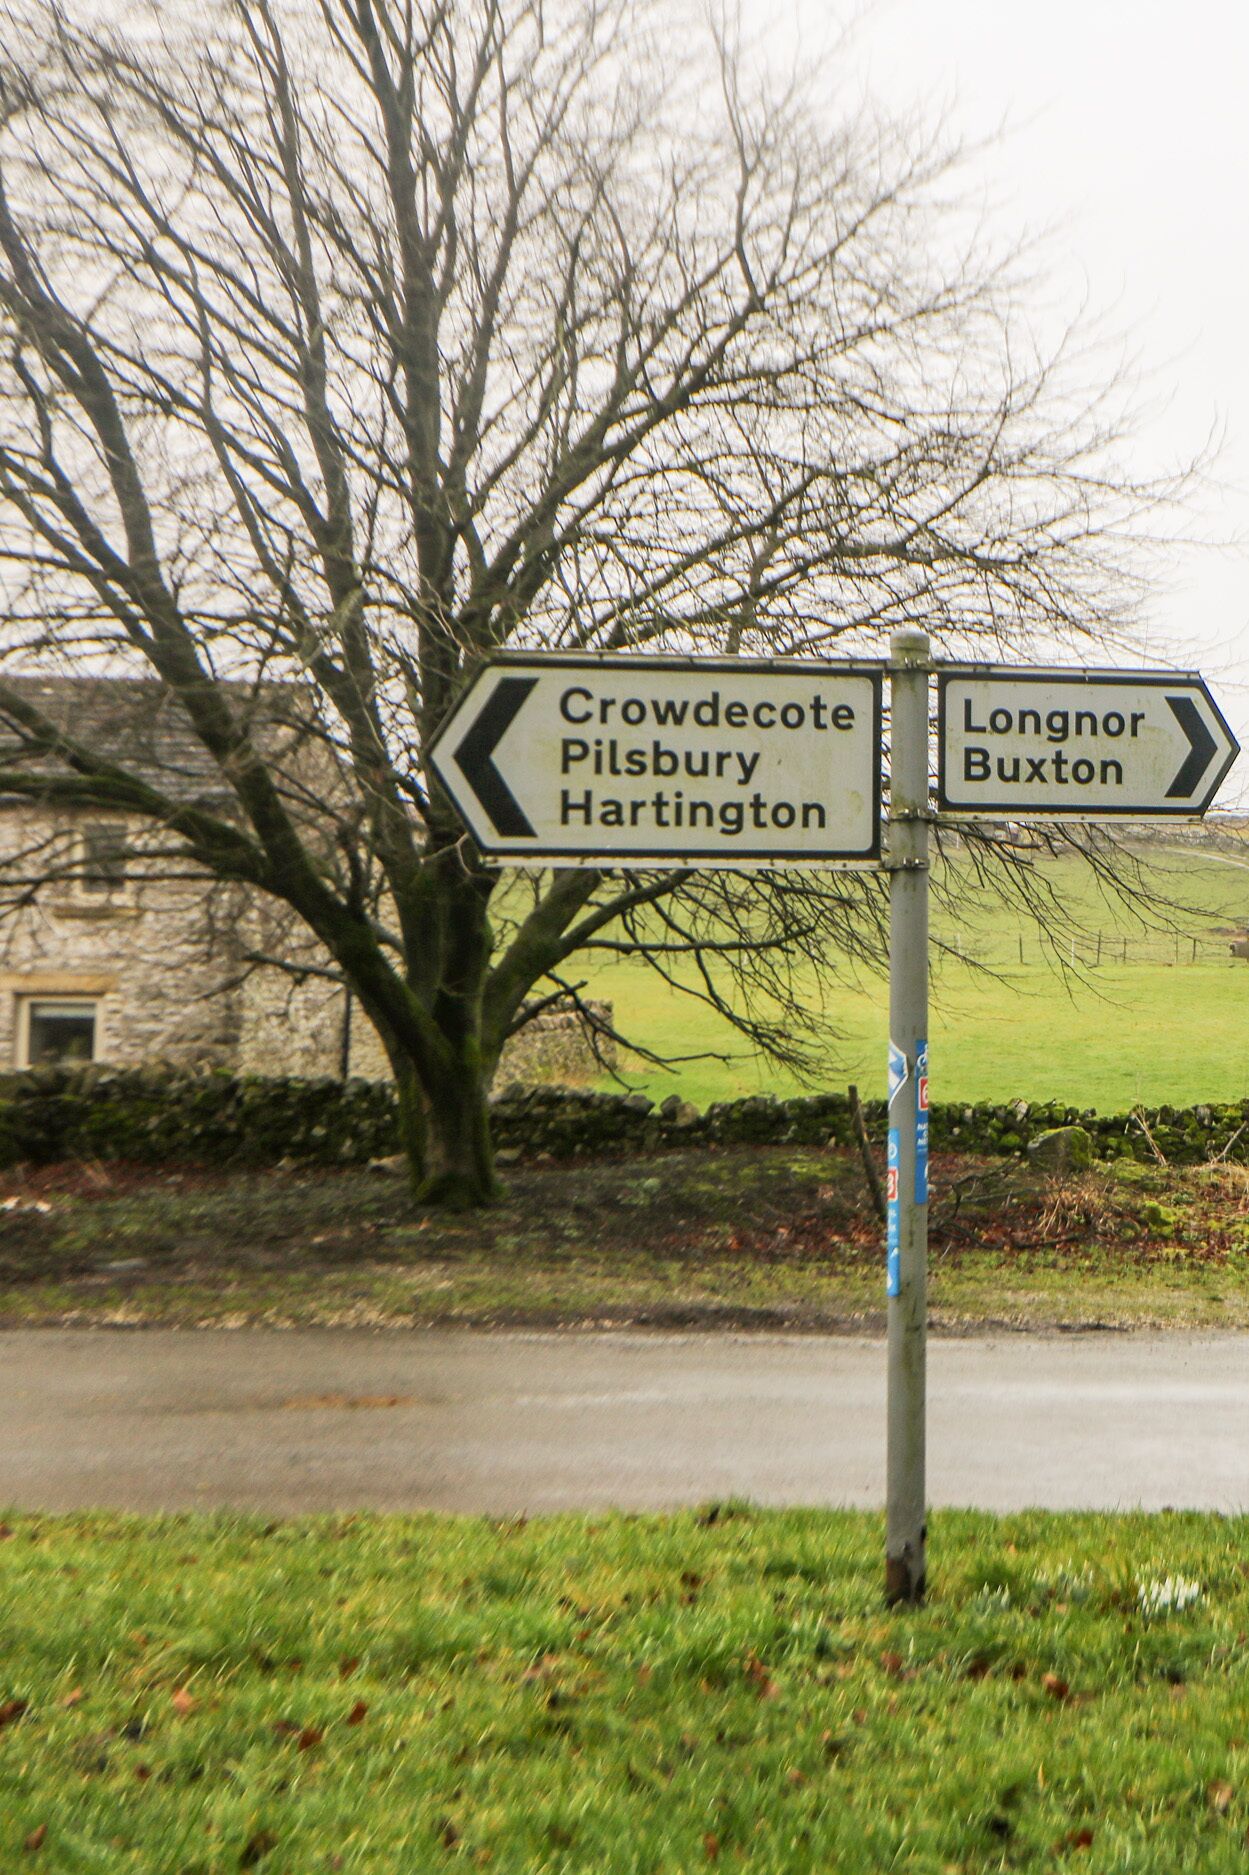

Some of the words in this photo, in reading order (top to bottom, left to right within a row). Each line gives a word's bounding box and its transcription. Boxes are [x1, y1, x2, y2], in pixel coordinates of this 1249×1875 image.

[559, 686, 857, 732] Crowdecote
[963, 698, 1146, 744] Longnor
[560, 737, 761, 786] Pilsbury
[963, 746, 1123, 786] Buxton
[560, 788, 826, 837] Hartington
